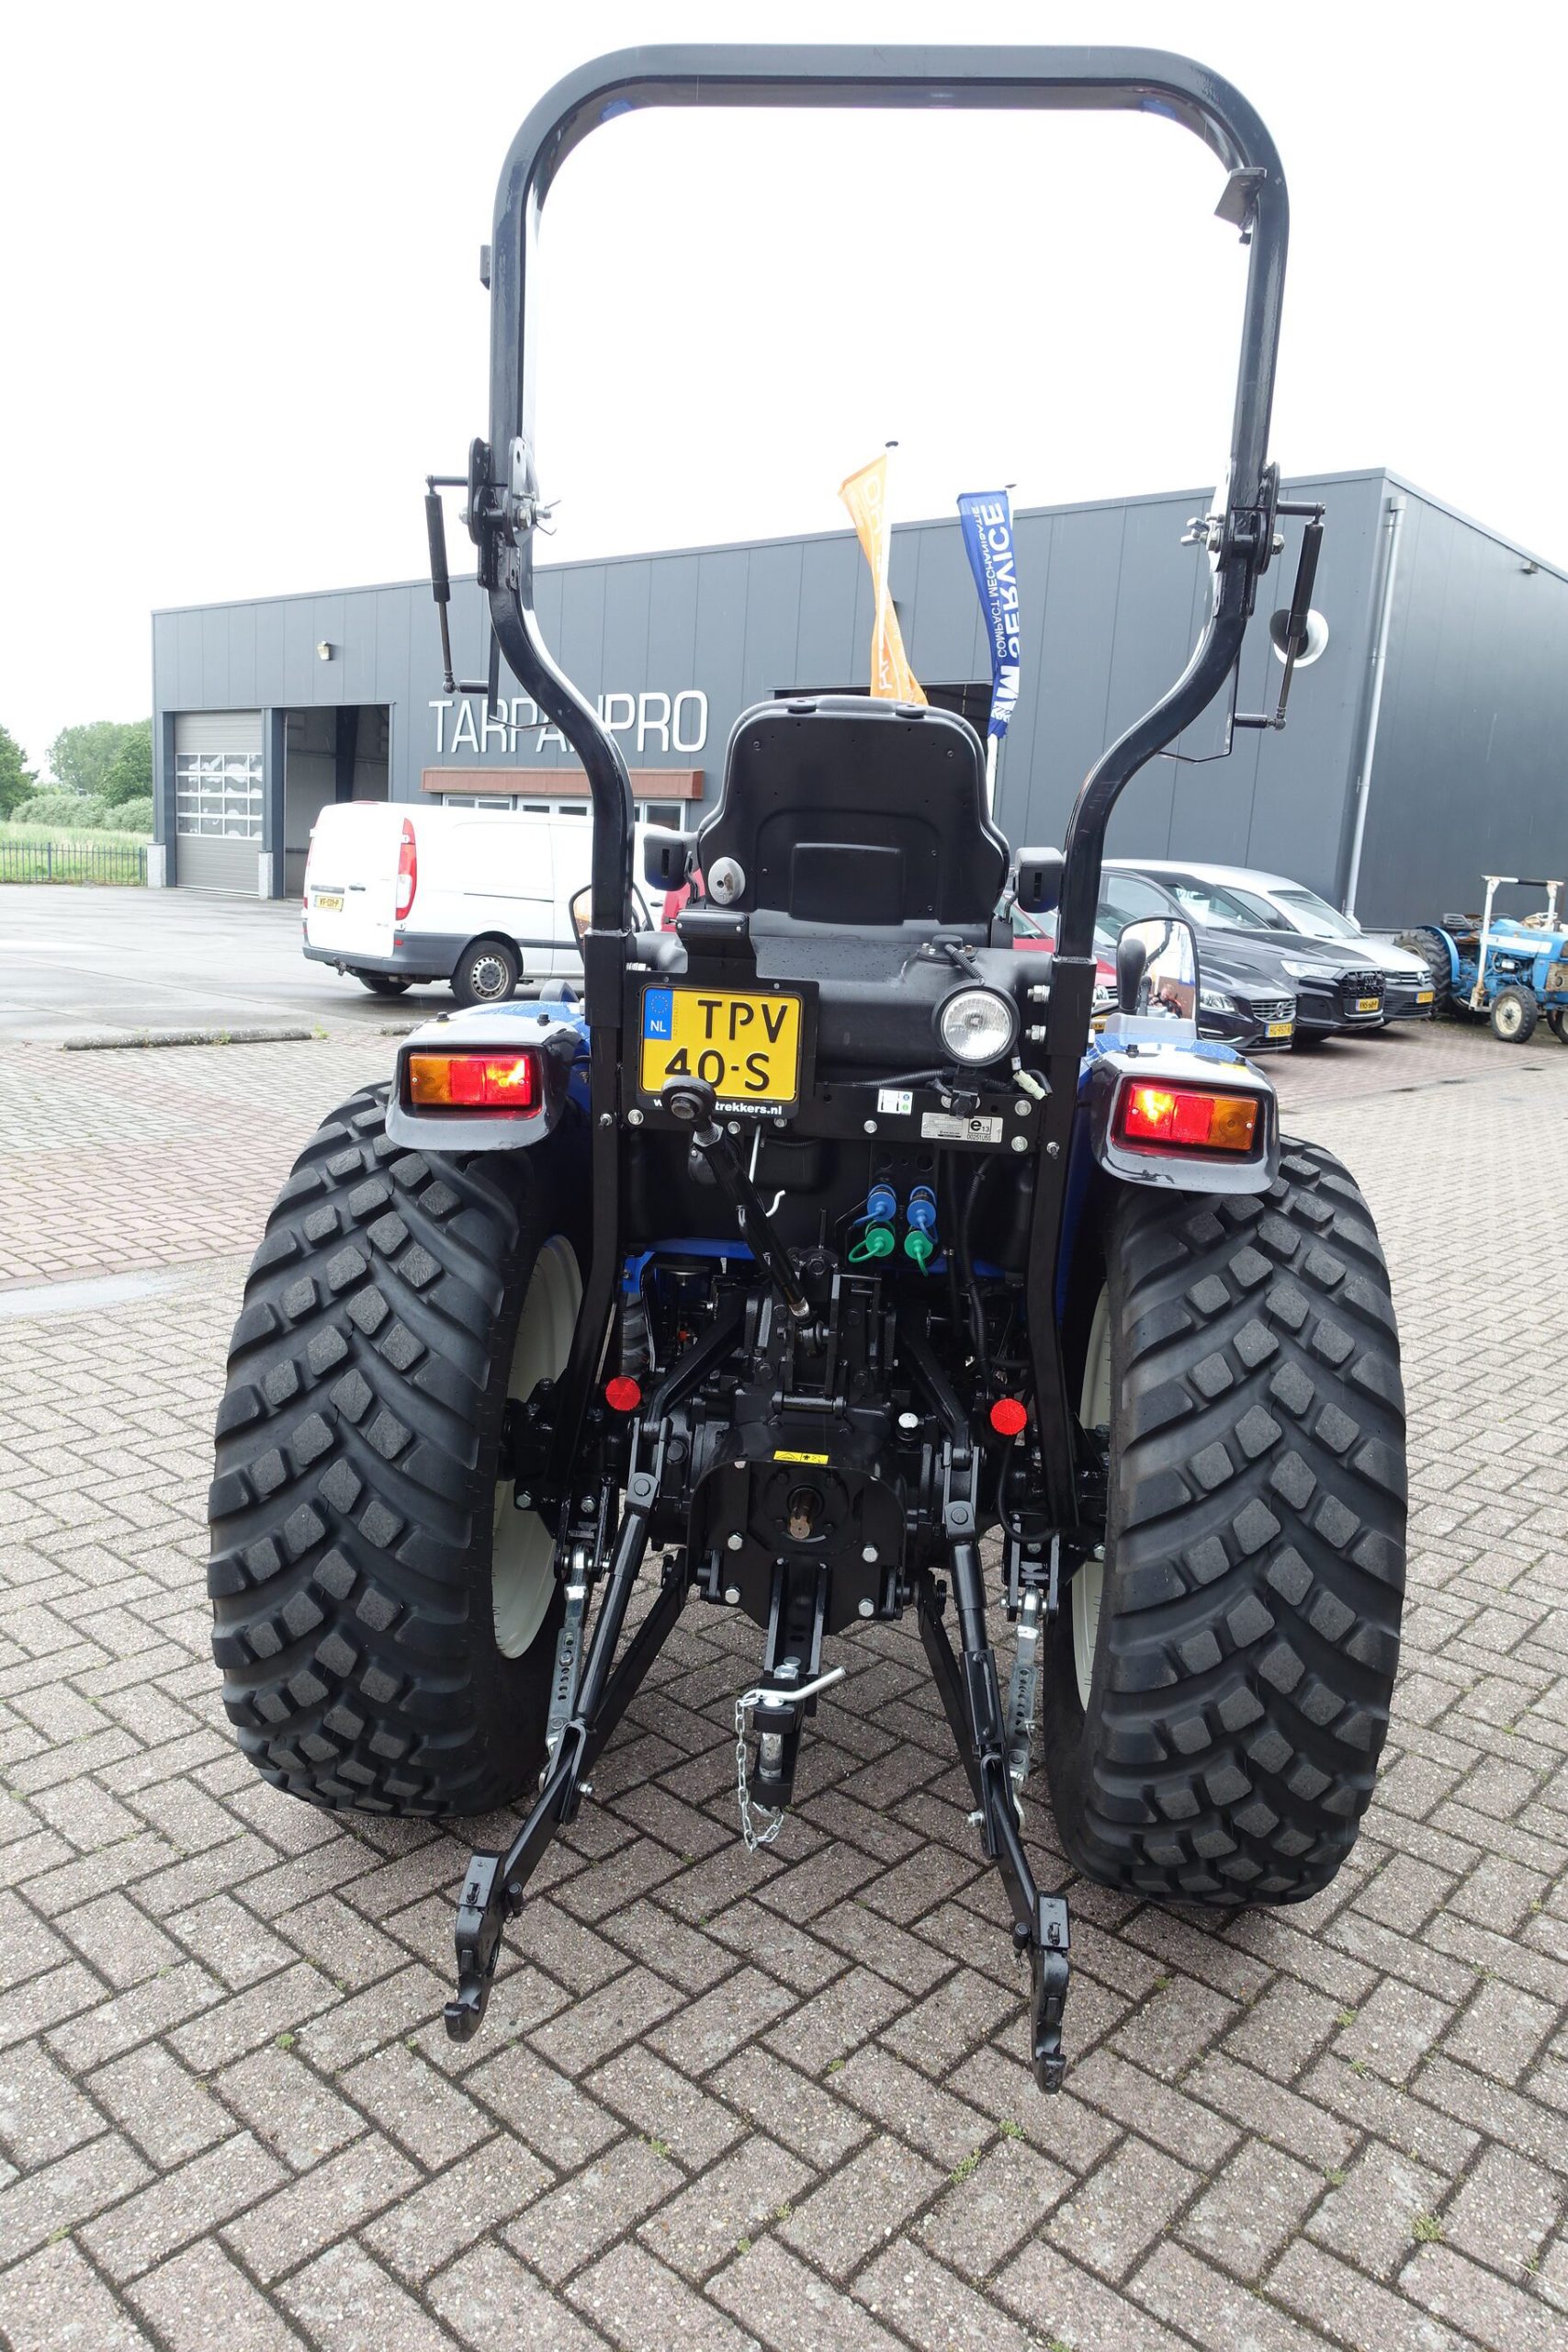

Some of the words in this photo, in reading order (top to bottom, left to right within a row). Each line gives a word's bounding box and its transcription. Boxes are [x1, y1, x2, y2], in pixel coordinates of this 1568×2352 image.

[428, 690, 708, 753] TARPAPRO
[650, 1020, 667, 1033] NL
[697, 999, 788, 1044] TPV
[664, 1047, 770, 1091] 40-S
[970, 1120, 983, 1132] e
